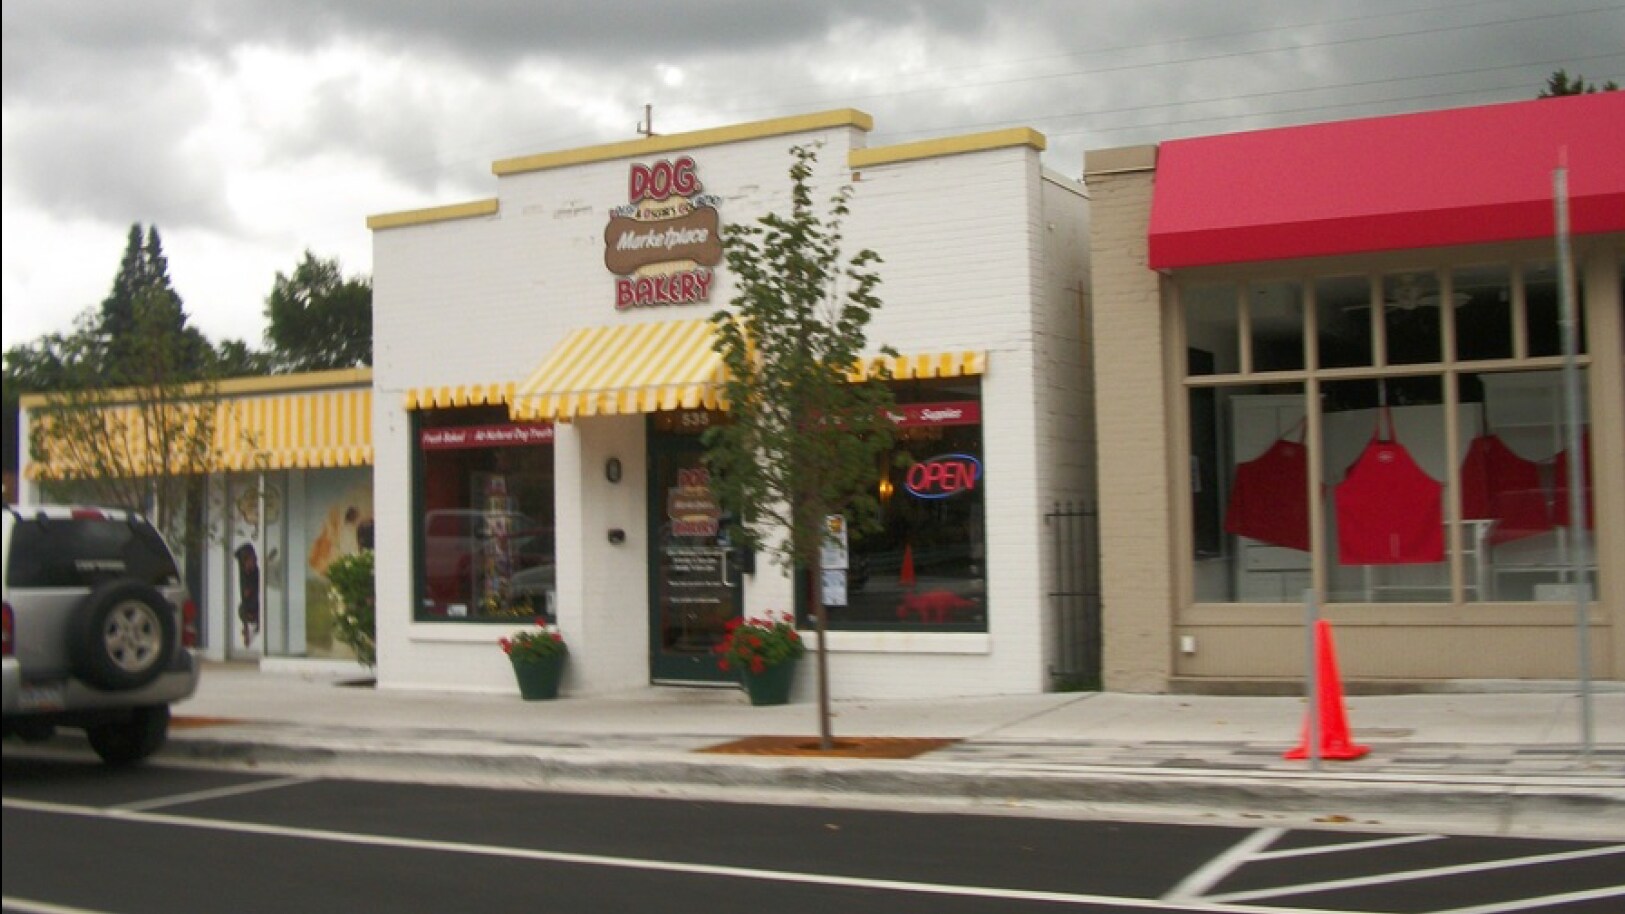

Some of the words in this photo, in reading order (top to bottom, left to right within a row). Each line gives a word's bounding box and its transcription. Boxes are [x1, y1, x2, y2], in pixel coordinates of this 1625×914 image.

[616, 227, 708, 250] Marketplace
[616, 270, 712, 308] BAKERY
[513, 427, 529, 443] Dog
[906, 461, 977, 491] OPEN
